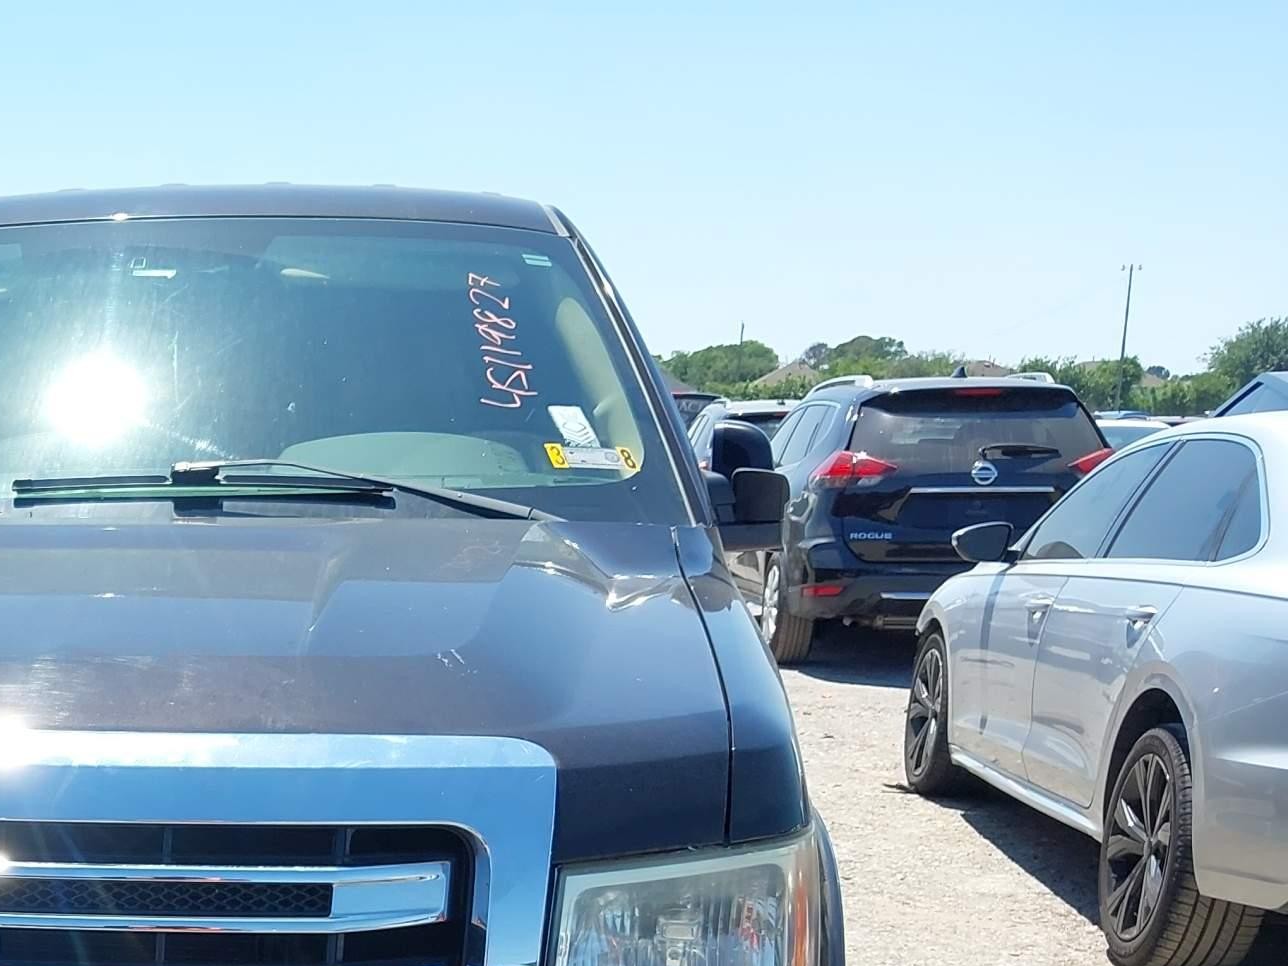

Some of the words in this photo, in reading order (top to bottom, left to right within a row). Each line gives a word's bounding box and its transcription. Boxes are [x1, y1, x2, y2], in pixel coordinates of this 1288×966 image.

[467, 271, 539, 409] 45119827
[549, 445, 566, 466] 3
[620, 448, 637, 469] 8
[849, 531, 893, 541] ROGUE
